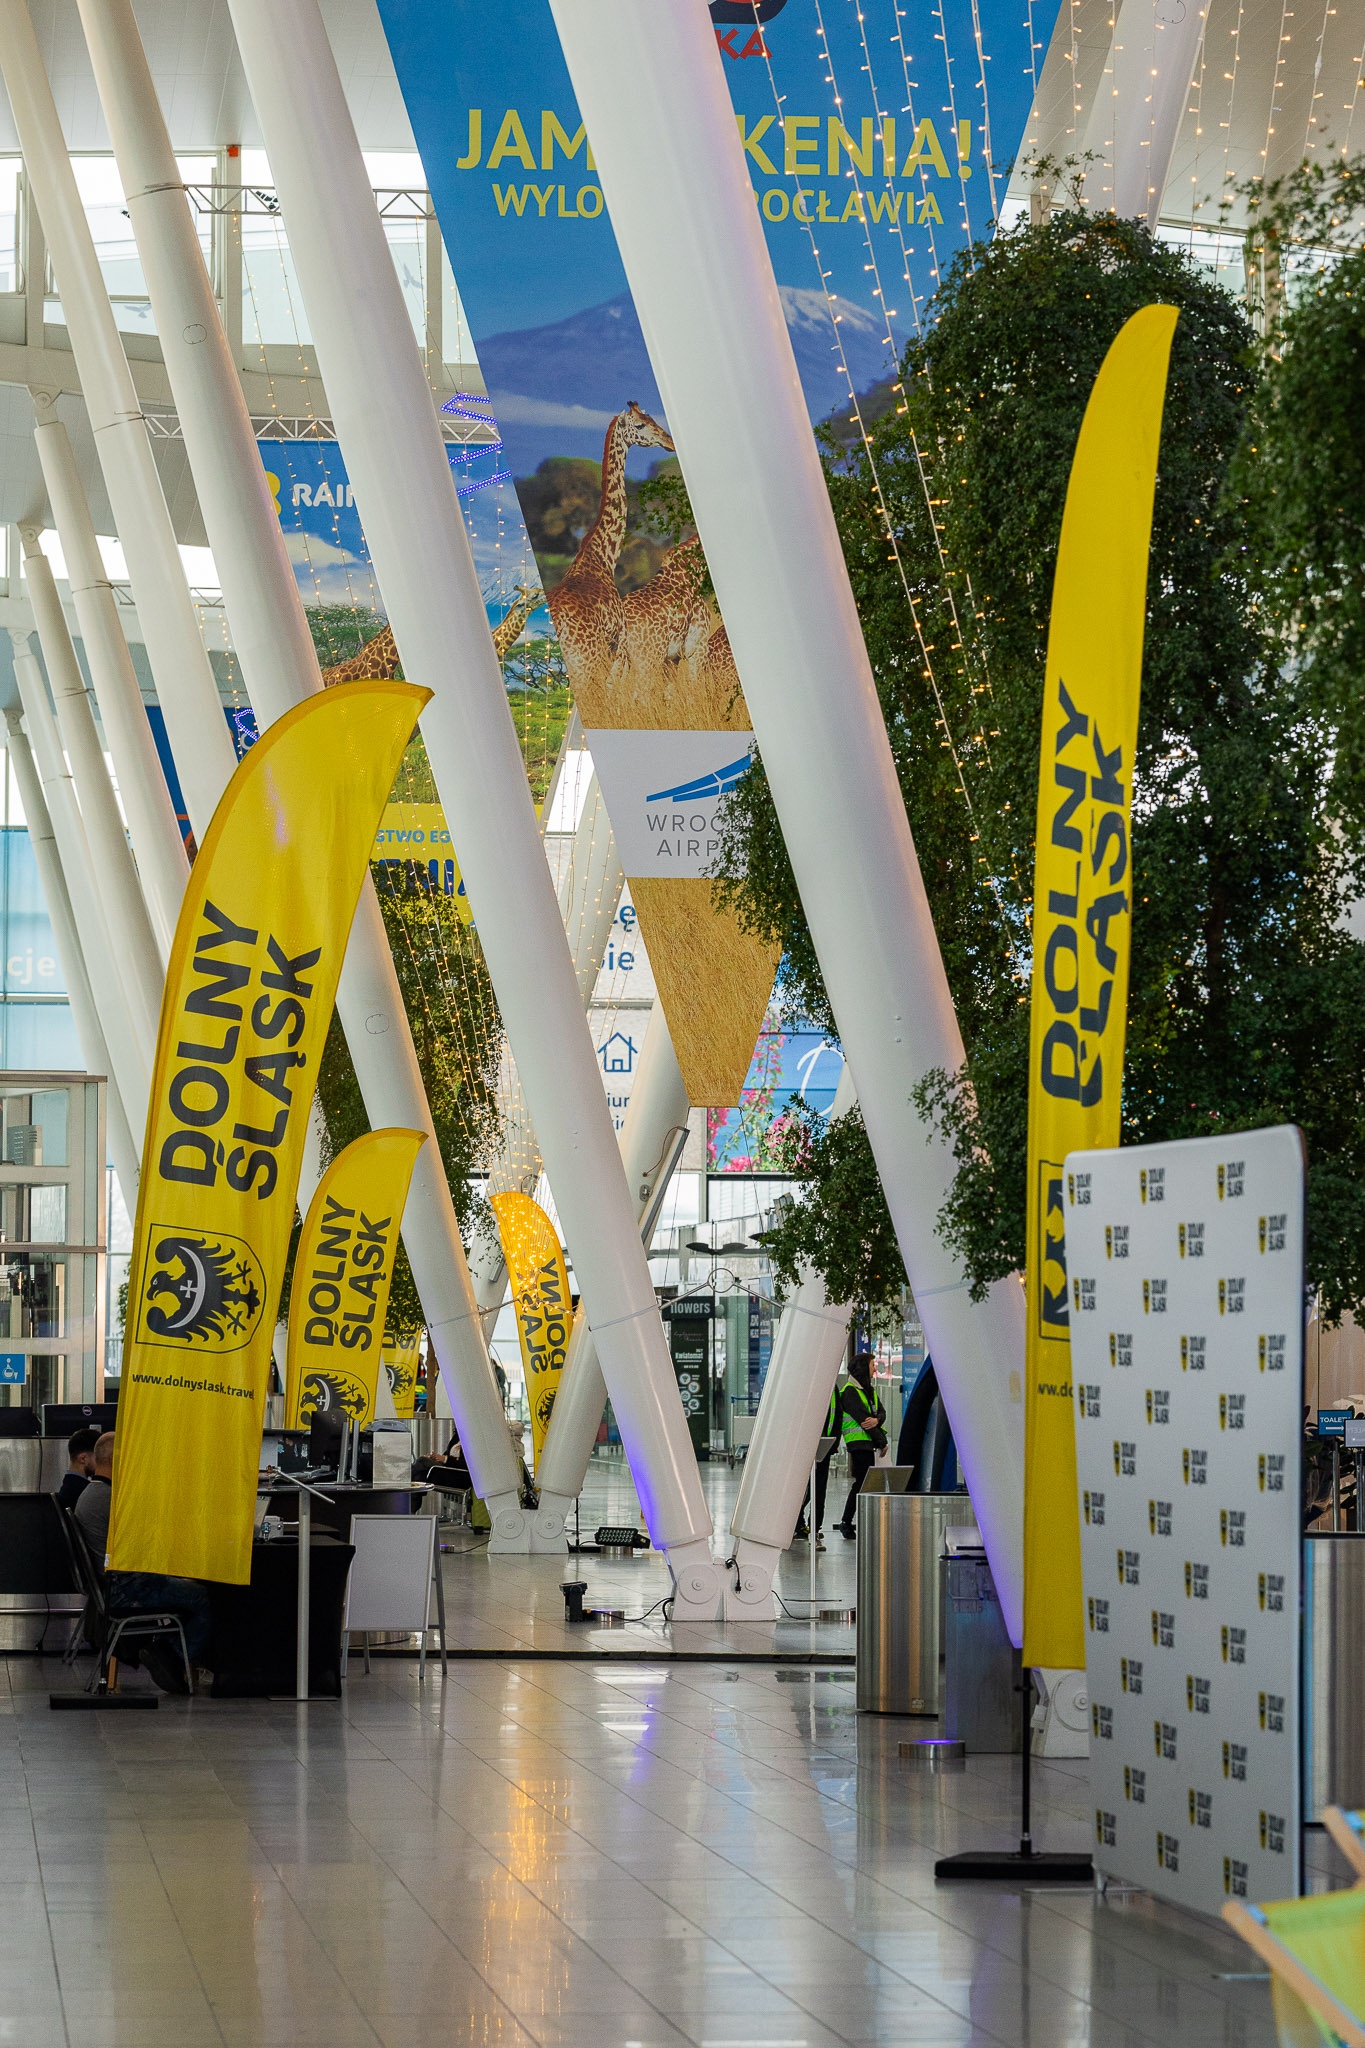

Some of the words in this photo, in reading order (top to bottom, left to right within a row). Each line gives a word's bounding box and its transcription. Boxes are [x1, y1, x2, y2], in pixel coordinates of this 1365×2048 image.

[713, 28, 773, 60] KA
[456, 108, 597, 171] JAM
[735, 114, 973, 179] KENIA!
[491, 184, 603, 218] WYLO
[754, 188, 945, 225] OCŁAWIA
[375, 829, 425, 843] STWO
[429, 830, 450, 843] EG
[646, 814, 730, 832] WROC
[656, 839, 719, 857] AIRP
[1041, 676, 1088, 1101] DOLNY
[7, 947, 56, 985] cje
[159, 900, 258, 1188] DOLNY
[213, 935, 321, 1200] ŚLĄSK
[303, 1195, 356, 1346] DOLNY
[332, 1211, 392, 1352] ŚLĄSK
